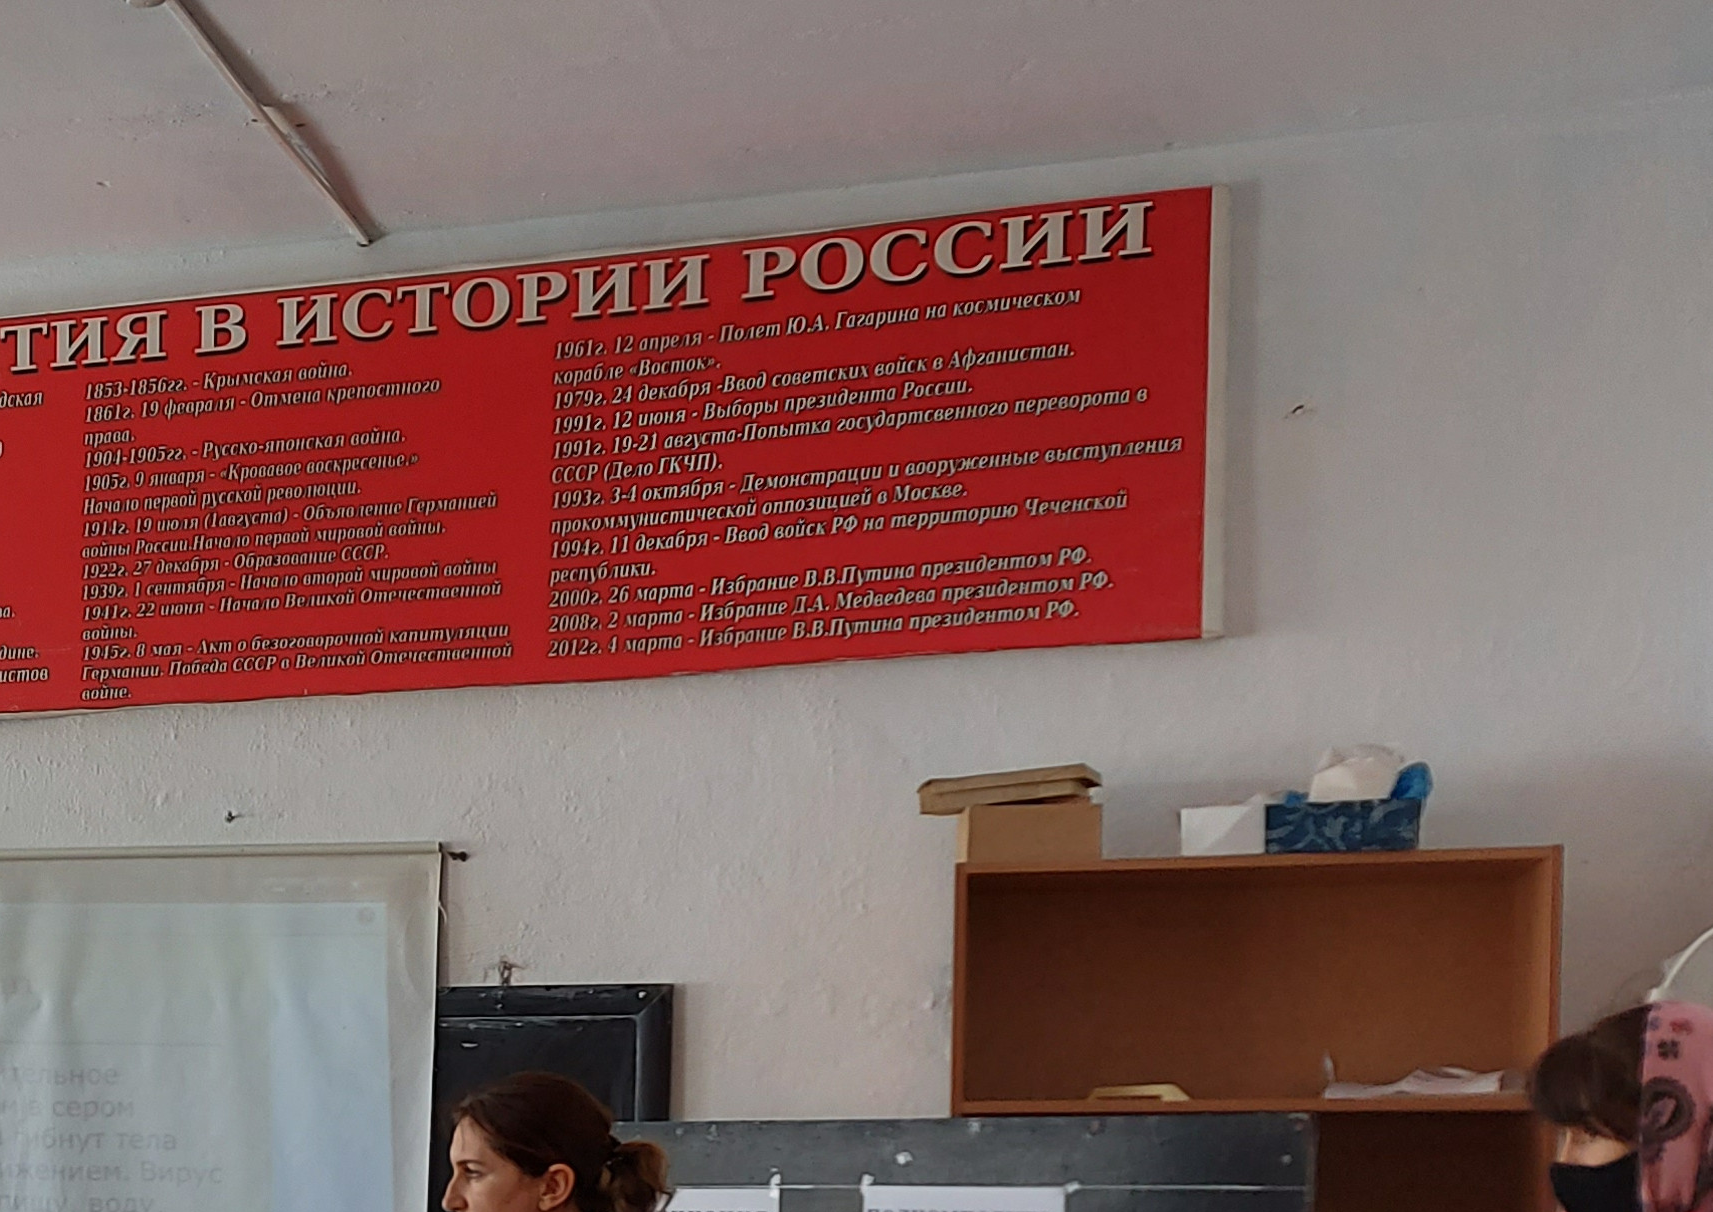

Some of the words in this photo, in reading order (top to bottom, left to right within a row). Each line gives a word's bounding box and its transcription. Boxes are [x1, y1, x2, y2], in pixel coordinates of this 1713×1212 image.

[194, 303, 247, 355] В
[275, 254, 711, 347] ИСТОРИИ
[741, 201, 1155, 300] РОССИИ
[85, 376, 188, 401] 1853-1856гг.
[203, 369, 293, 392] Крымская
[297, 361, 353, 381] война.
[553, 362, 625, 388] корабле
[554, 389, 608, 410] 1979г.
[611, 384, 633, 405] 24
[637, 378, 712, 402] декабря
[771, 365, 869, 388] советских
[873, 356, 929, 377] войск
[931, 356, 944, 371] в
[947, 343, 1075, 372] Афганистан.
[553, 413, 607, 435] 1991г.
[612, 410, 634, 430] 12
[637, 409, 687, 427] июня
[702, 398, 779, 421] Выборы
[783, 387, 897, 416] президента
[901, 379, 974, 400] России.
[553, 438, 607, 460] 1991г.
[612, 431, 658, 455] 19-21
[836, 401, 1009, 434] государтсвенного
[1013, 389, 1131, 417] переворота
[1136, 388, 1148, 403] в
[84, 429, 135, 449] права.
[551, 463, 599, 485] СССР
[603, 461, 655, 482] (Дело
[657, 452, 723, 476] ГКЧП).
[83, 497, 140, 516] Начало
[143, 489, 198, 514] первой
[201, 484, 263, 511] русской
[266, 481, 362, 506] революции.
[550, 497, 758, 538] прокоммунистической
[761, 486, 873, 516] оппозицией
[876, 490, 888, 505] в
[891, 483, 968, 504] Москве.
[81, 541, 131, 559] войны
[254, 526, 310, 549] первой
[316, 521, 384, 545] мировой
[388, 519, 447, 537] войны.
[549, 560, 657, 588] республики.
[82, 624, 138, 641] войны.
[82, 665, 165, 683] Германии.
[168, 658, 228, 676] Победа
[232, 655, 278, 672] СССР
[280, 658, 290, 670] в
[295, 649, 366, 669] Великой
[370, 641, 513, 665] Отечественной
[81, 685, 133, 702] войне.
[139, 1160, 224, 1189] Вирус
